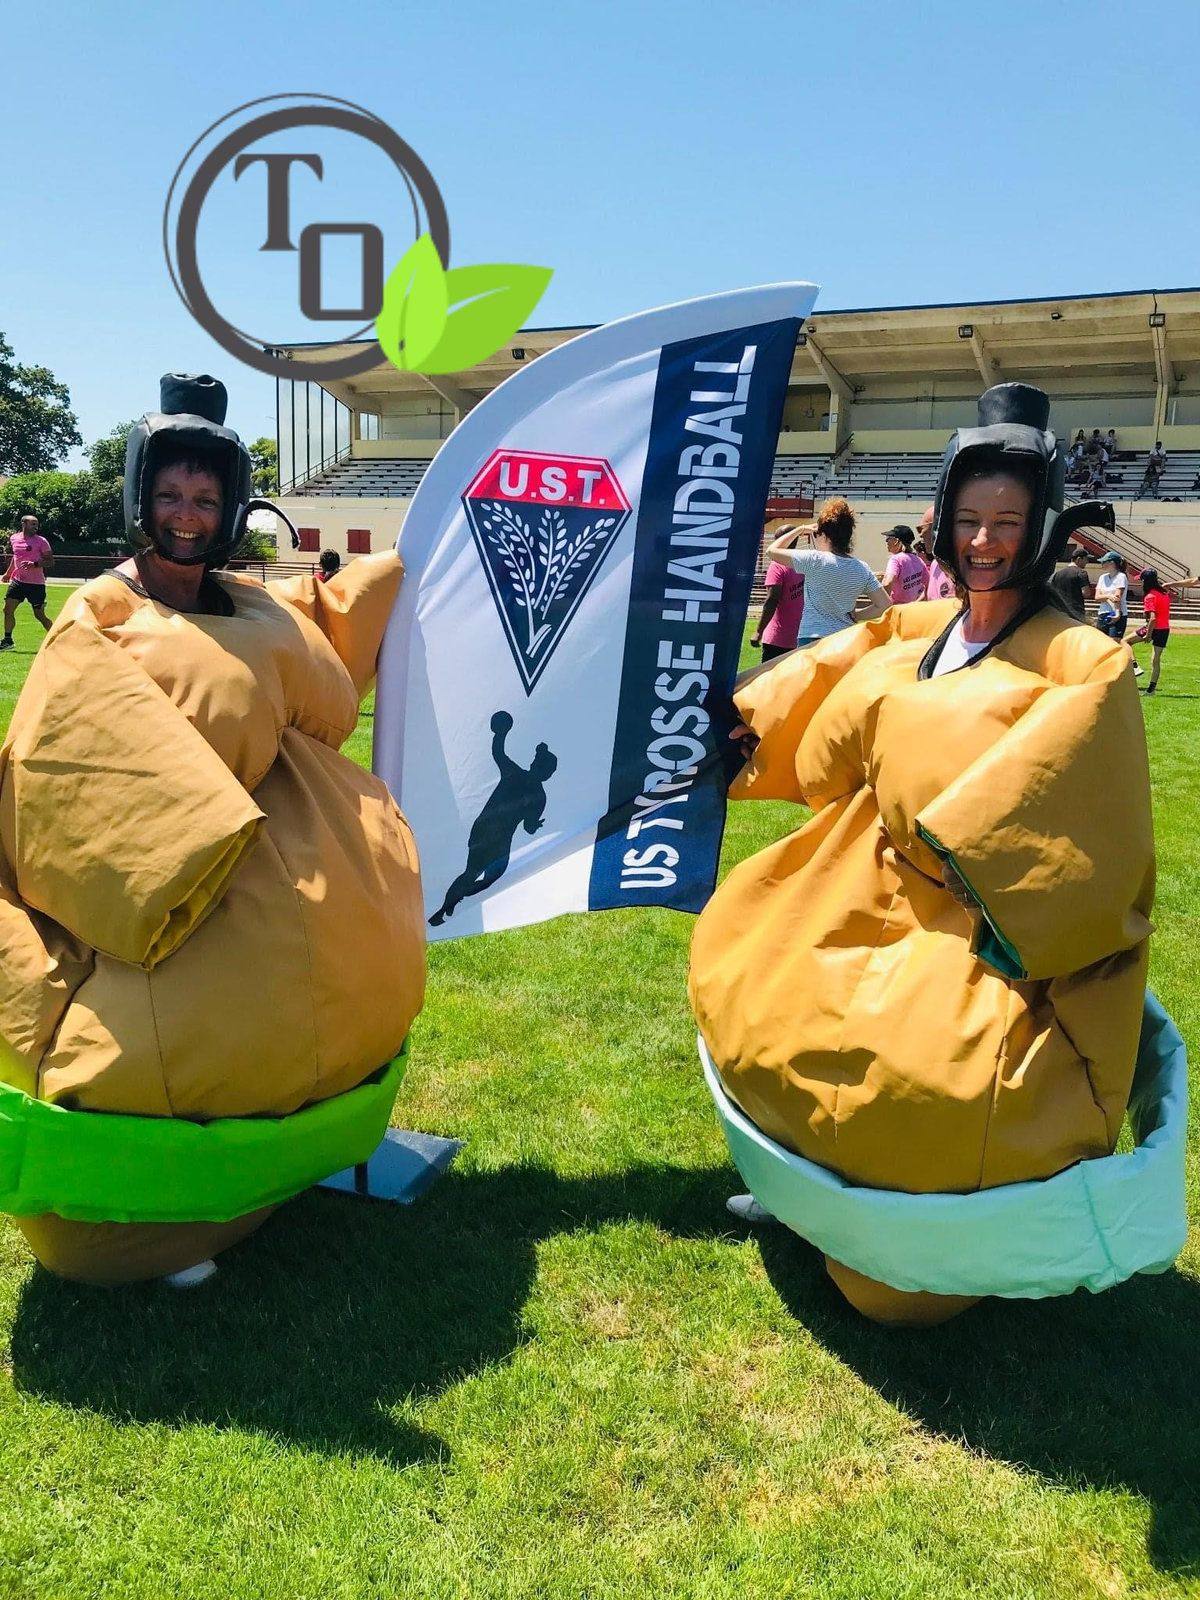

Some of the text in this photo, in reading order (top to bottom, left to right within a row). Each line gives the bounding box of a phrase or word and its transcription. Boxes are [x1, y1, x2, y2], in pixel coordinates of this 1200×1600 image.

[499, 461, 606, 505] U.S.T.
[620, 345, 757, 889] US TYROSSE HANDBALL
